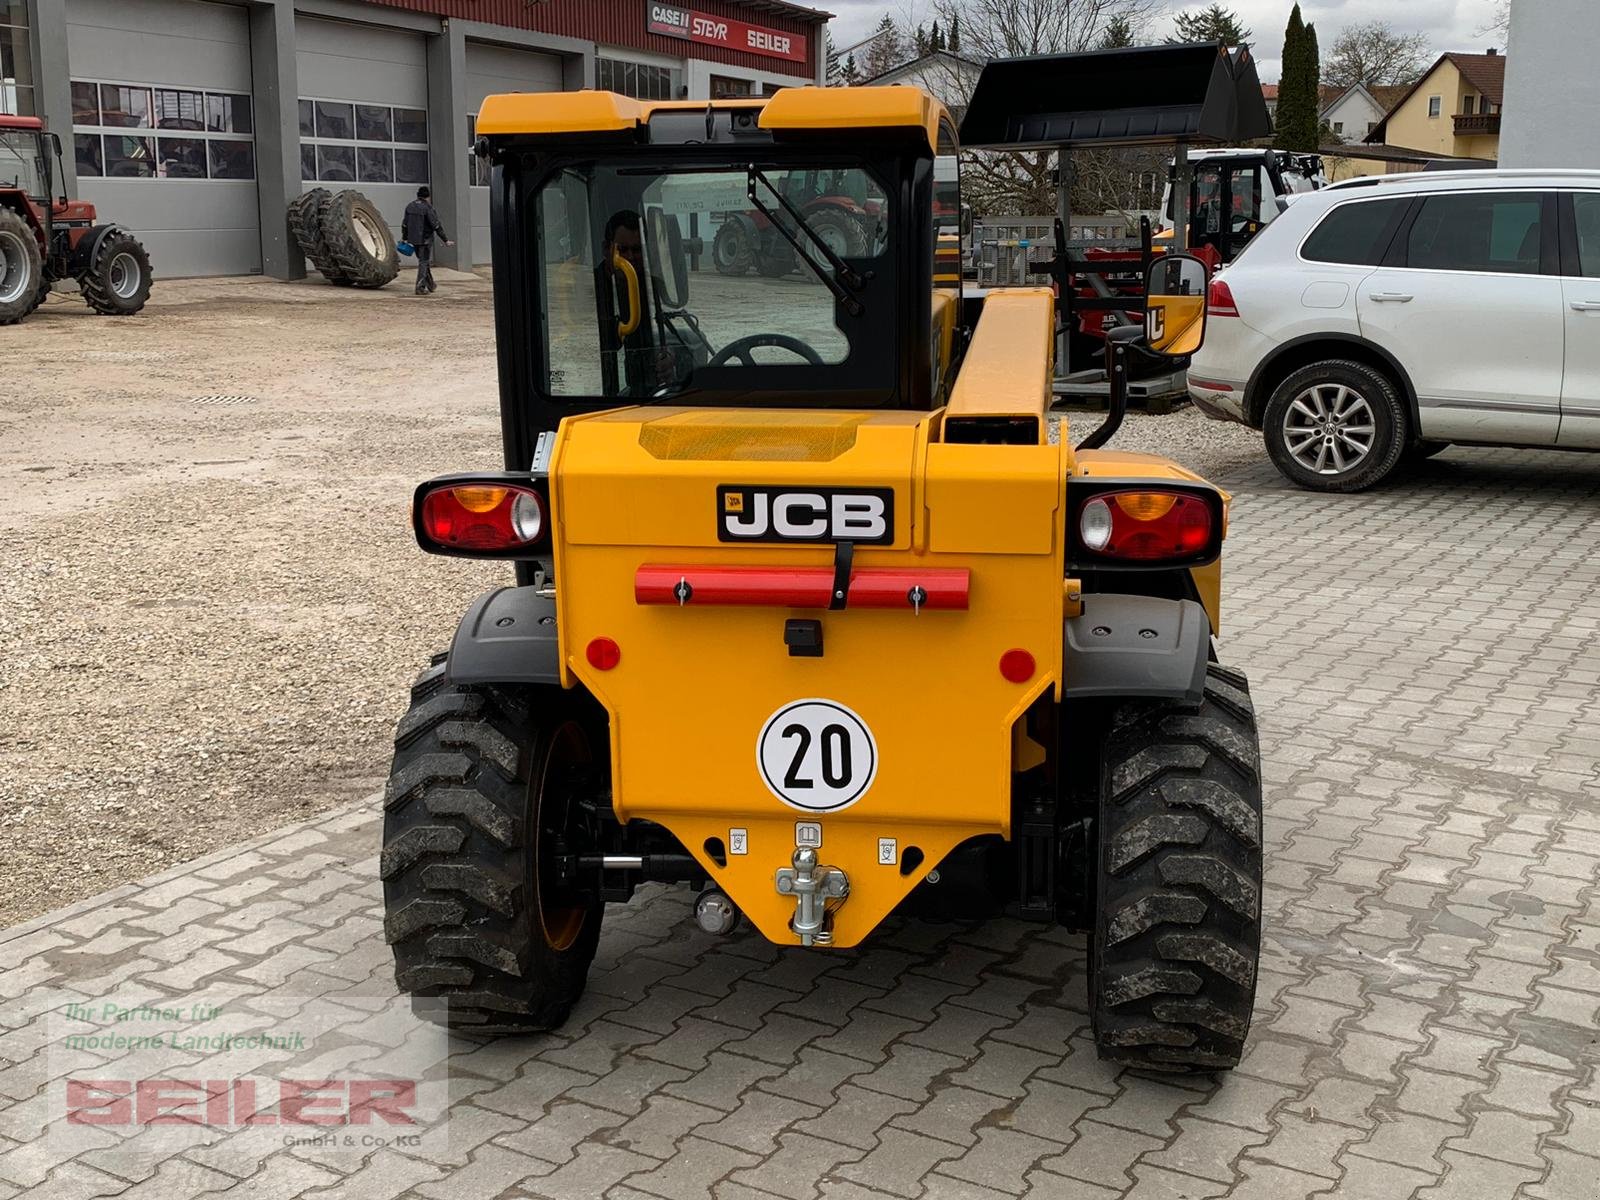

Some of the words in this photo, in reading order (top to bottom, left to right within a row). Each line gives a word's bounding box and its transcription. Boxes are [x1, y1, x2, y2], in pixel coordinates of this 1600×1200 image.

[692, 17, 728, 41] STEYR
[747, 29, 791, 55] SEILER
[725, 493, 886, 536] JCB
[781, 723, 852, 789] 20
